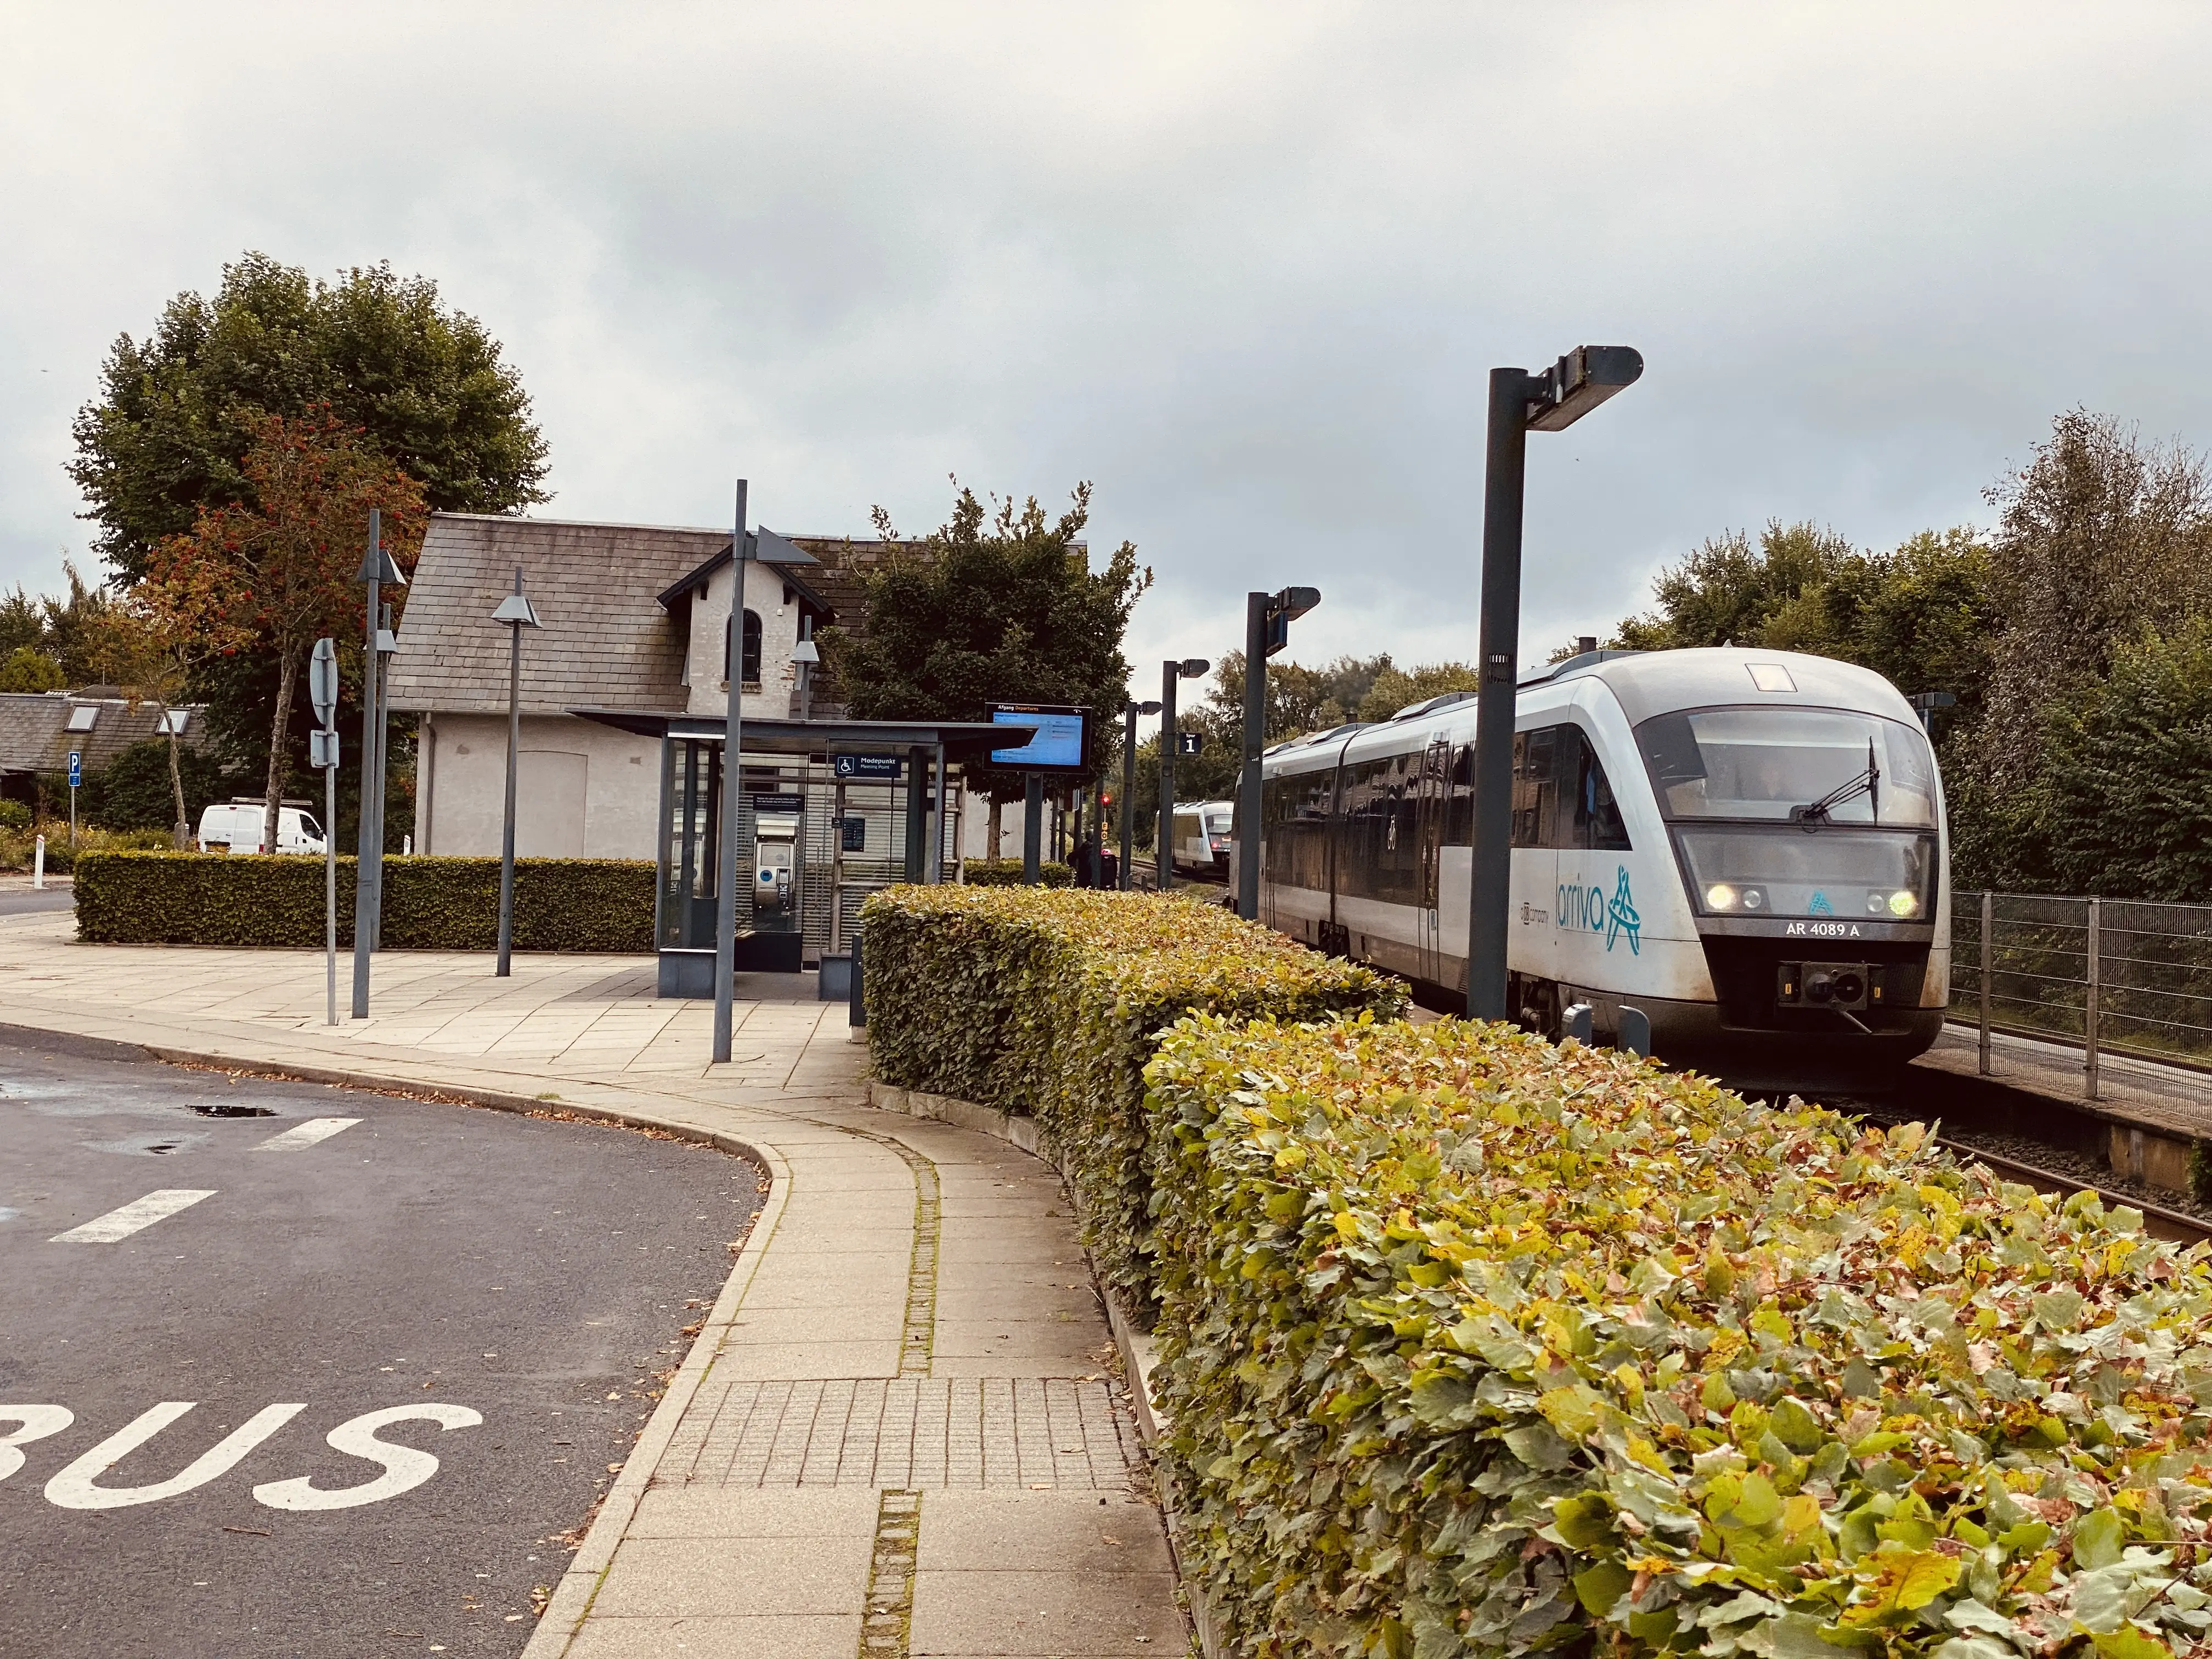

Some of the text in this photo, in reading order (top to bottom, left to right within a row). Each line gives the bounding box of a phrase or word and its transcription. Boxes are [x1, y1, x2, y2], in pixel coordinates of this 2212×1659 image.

[1186, 740, 1194, 752] 1
[71, 755, 78, 772] P
[1558, 873, 1604, 931] arriva
[1786, 923, 1860, 936] AR 4089 A
[0, 1402, 483, 1511] US
